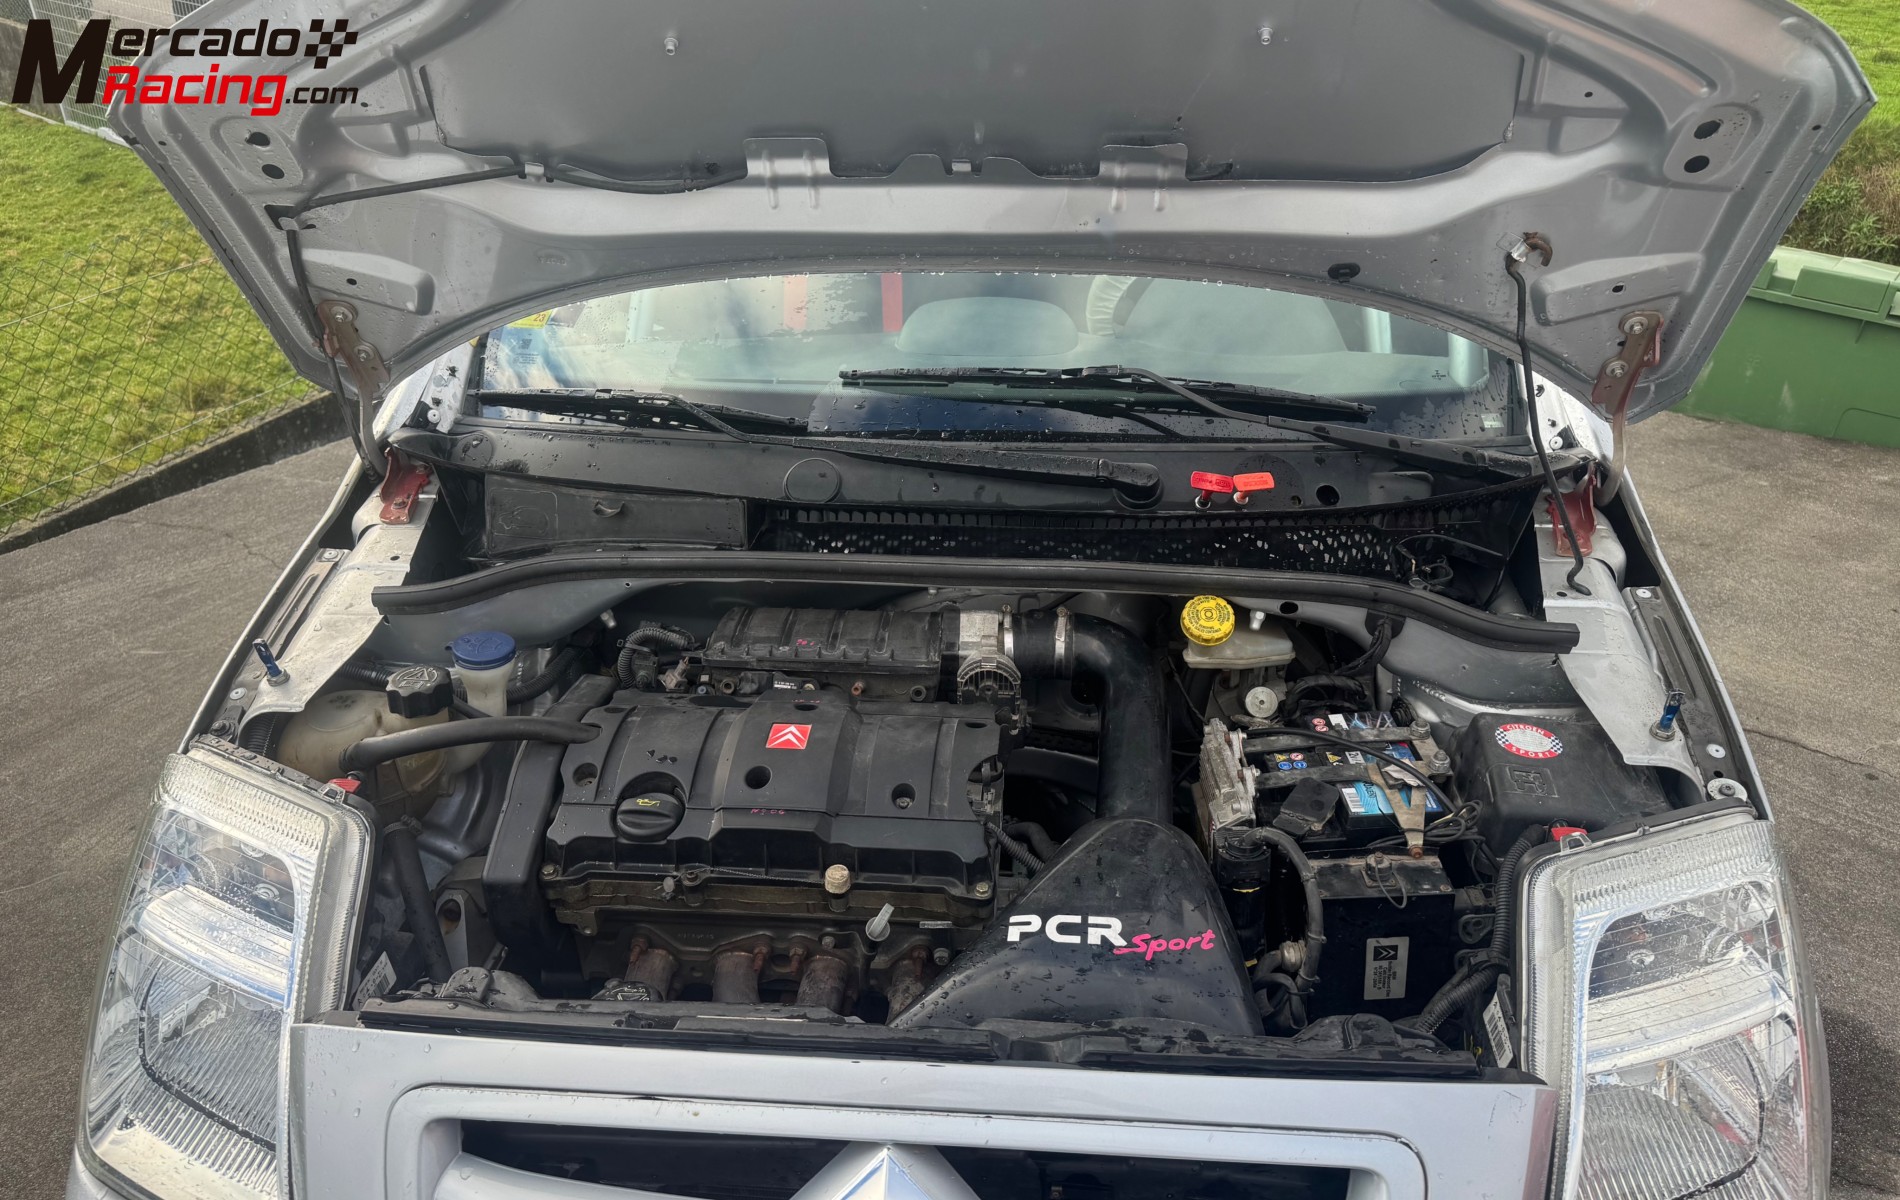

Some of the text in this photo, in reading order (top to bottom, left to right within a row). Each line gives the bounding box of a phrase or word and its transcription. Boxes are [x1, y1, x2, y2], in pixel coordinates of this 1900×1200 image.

[1511, 746, 1551, 758] SPORT
[1007, 914, 1216, 960] PCR Sport
